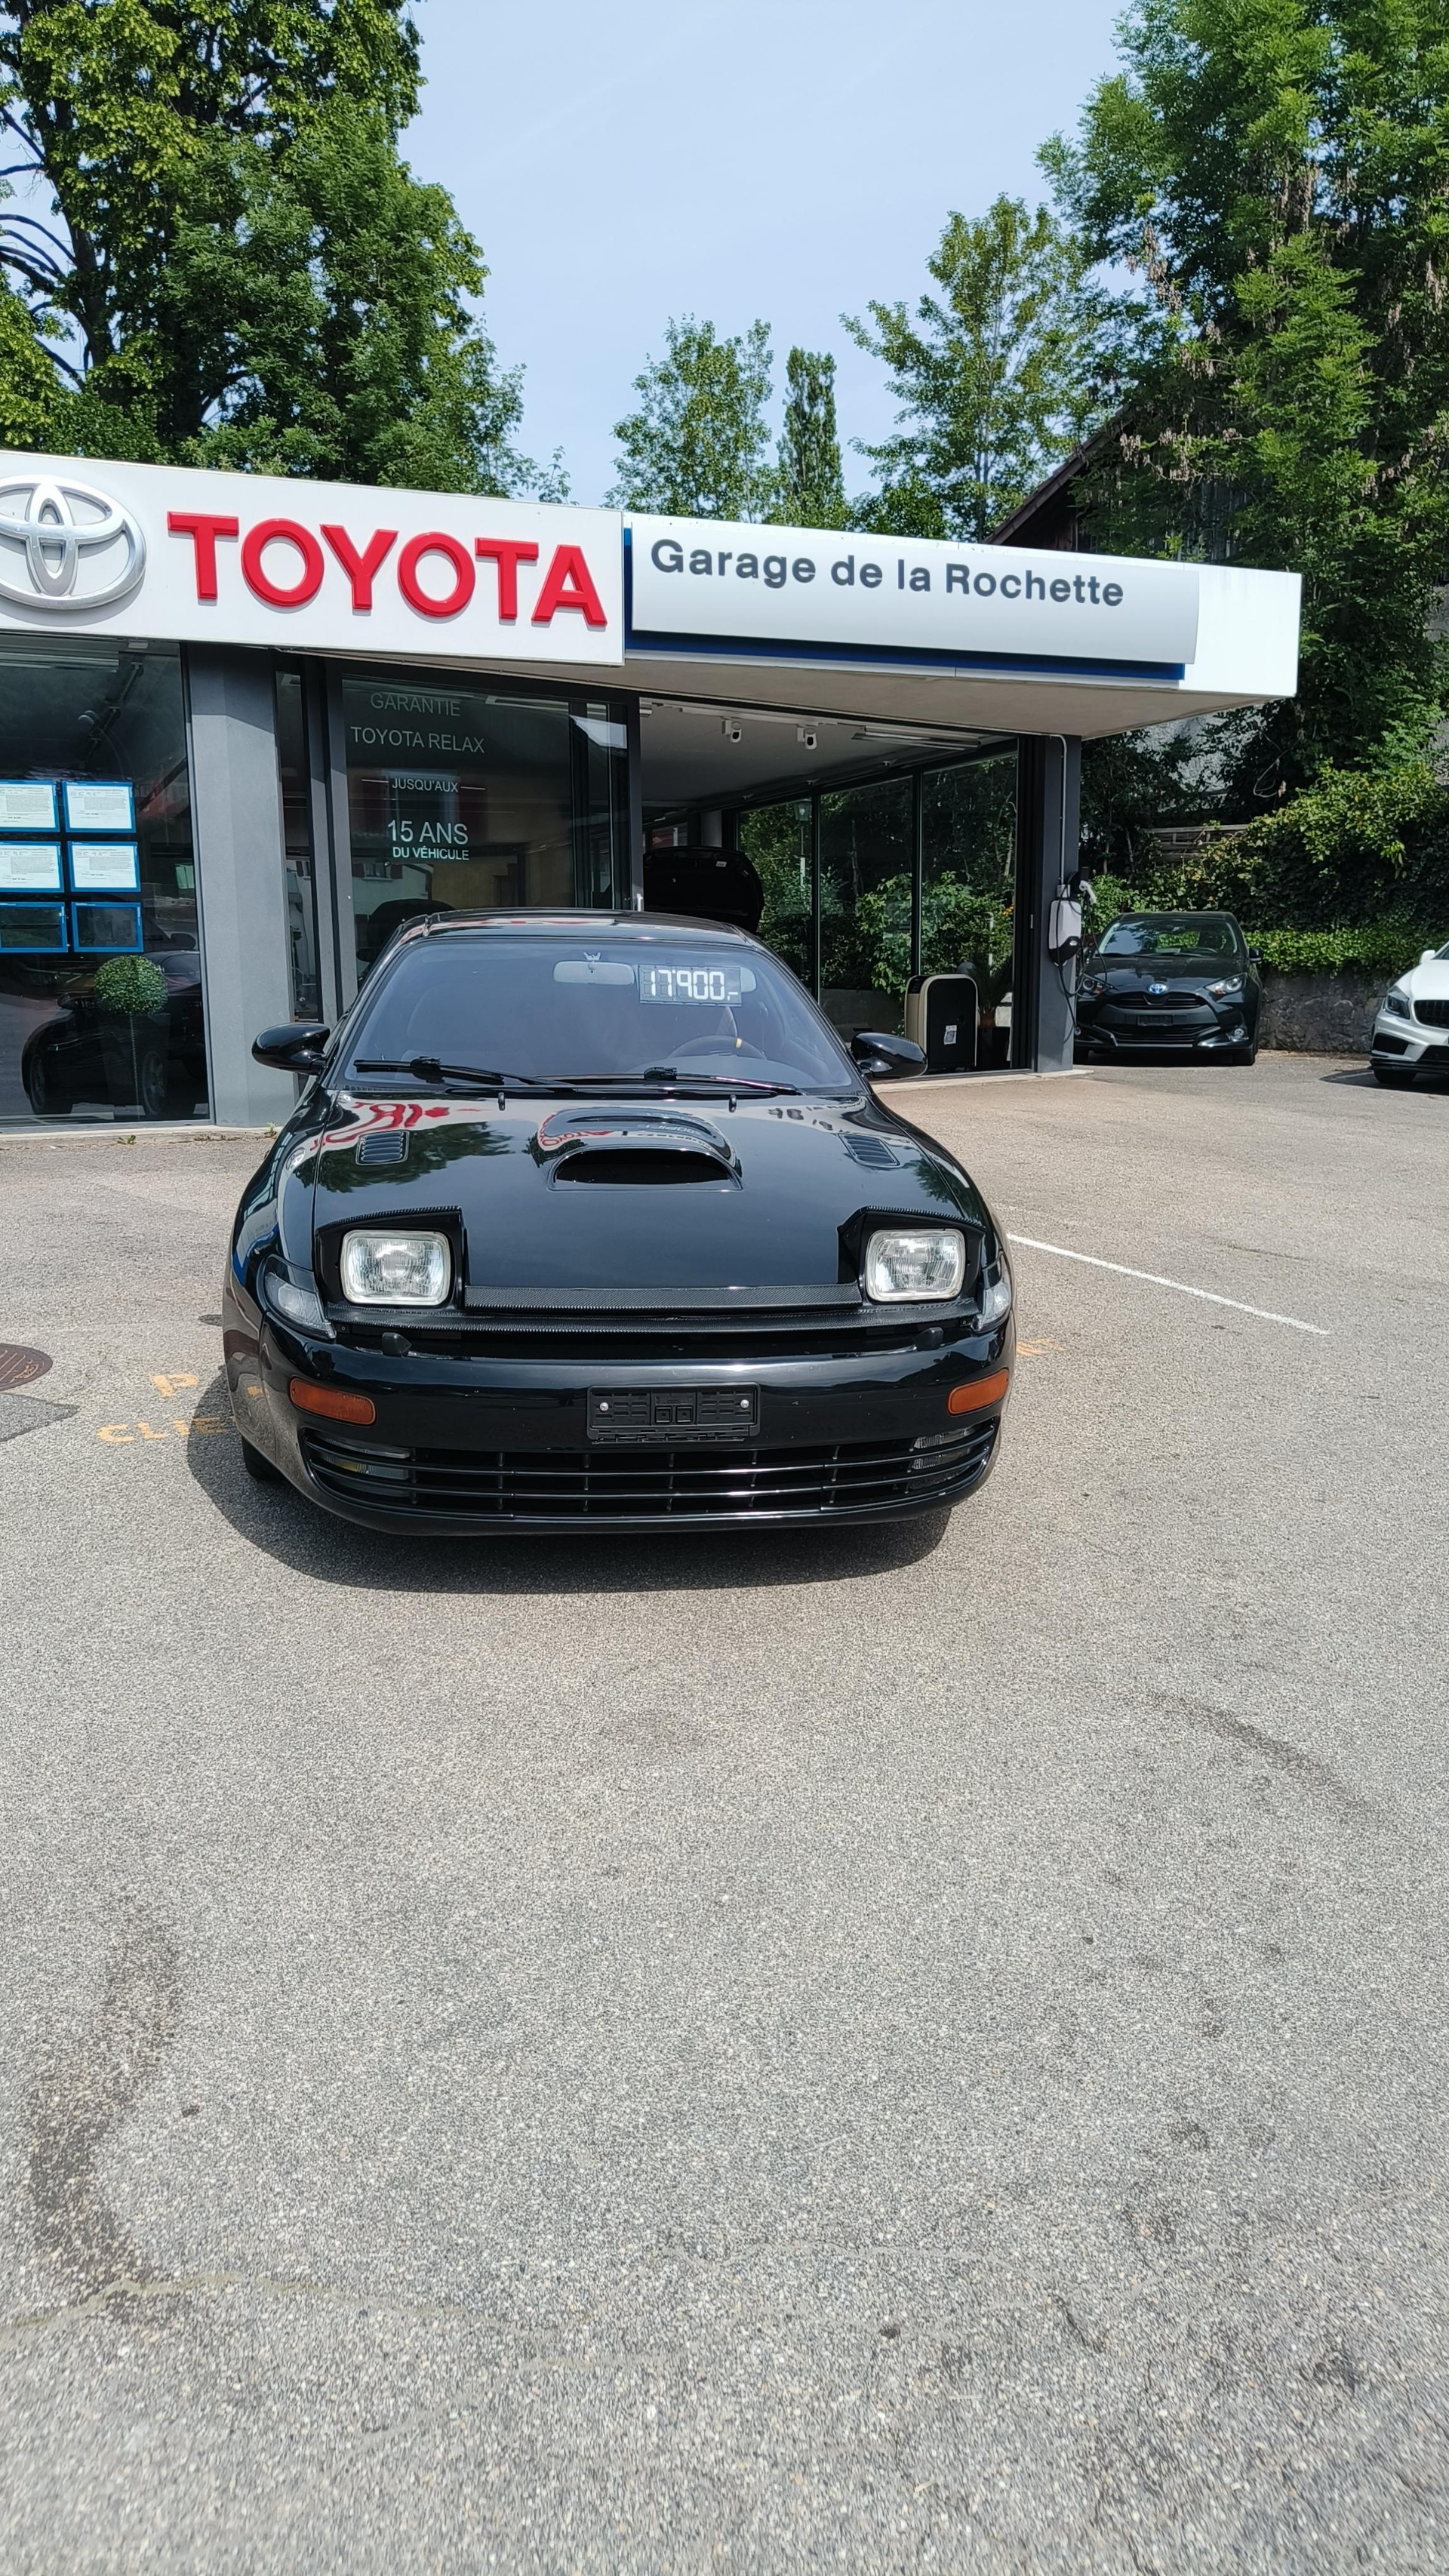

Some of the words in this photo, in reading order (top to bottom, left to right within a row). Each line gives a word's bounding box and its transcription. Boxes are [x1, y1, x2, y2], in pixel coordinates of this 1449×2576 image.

[167, 511, 608, 629] TOYOTA
[651, 538, 816, 589] Garage
[830, 555, 883, 589] de
[897, 559, 931, 592] la
[946, 564, 1124, 607] Rochette
[370, 692, 461, 716] GARANTIE
[350, 726, 425, 748] TOYOTA
[428, 733, 485, 754] RELAX
[392, 777, 459, 793] JUSQU'AUX
[387, 820, 414, 842] 15
[419, 821, 469, 845] ANS
[392, 846, 410, 858] DU
[412, 845, 469, 860] VÉHICULE
[152, 1372, 199, 1397] P
[96, 1415, 235, 1444] CLIE
